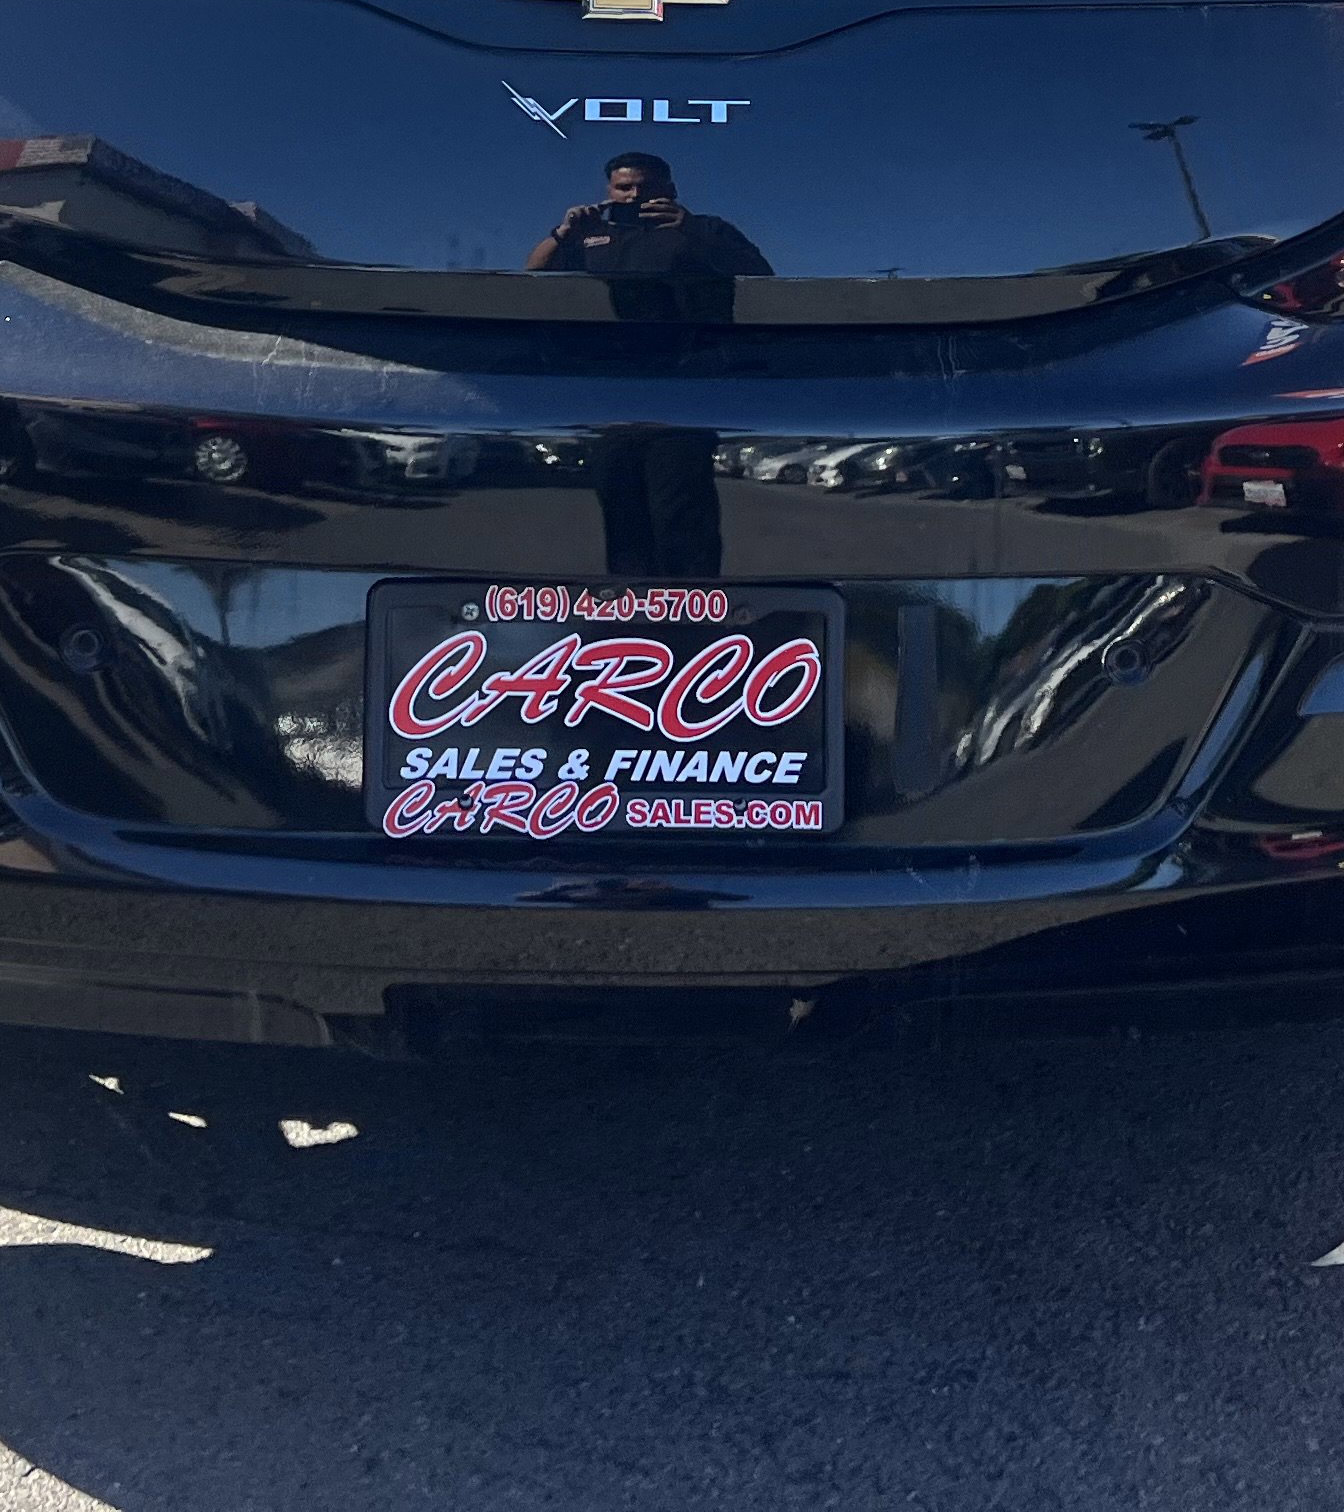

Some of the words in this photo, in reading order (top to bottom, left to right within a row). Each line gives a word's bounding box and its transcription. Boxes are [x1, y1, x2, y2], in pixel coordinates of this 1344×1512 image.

[501, 80, 751, 139] VOLT
[485, 584, 570, 623] (619)
[575, 586, 729, 623] 420-5700
[388, 629, 821, 742] CARCO
[400, 747, 548, 781] SALES
[557, 748, 590, 781] &
[605, 749, 807, 784] FINANCE
[382, 779, 620, 840] CARCO
[625, 799, 824, 830] SALES.COM
